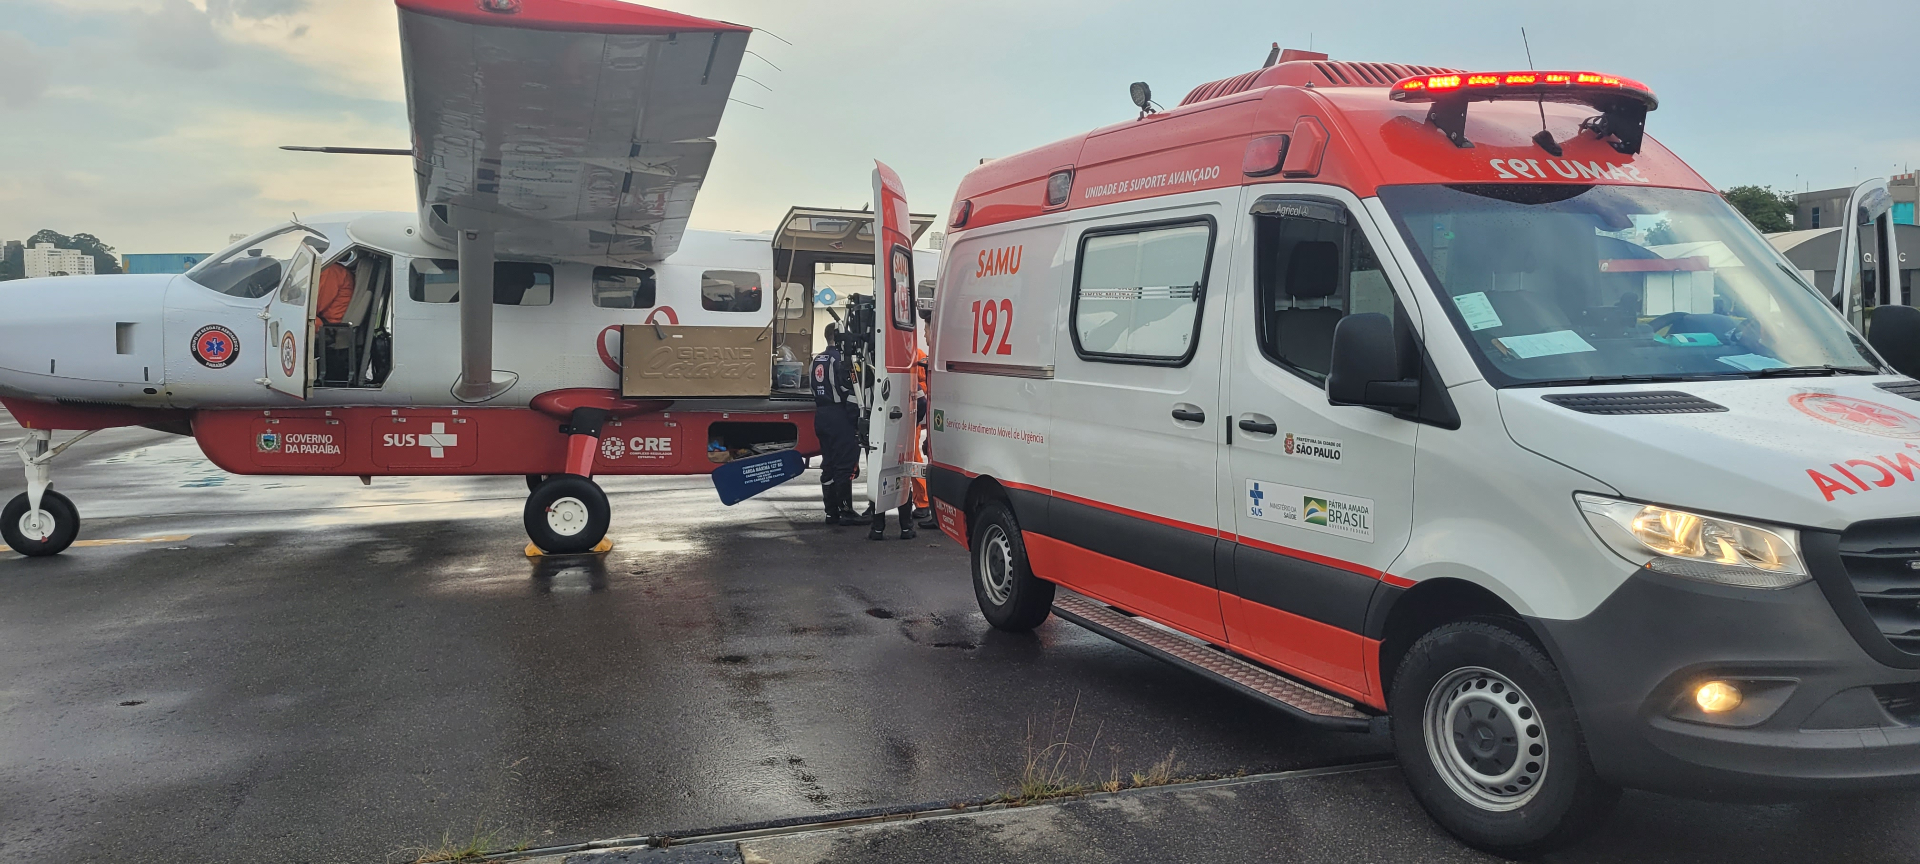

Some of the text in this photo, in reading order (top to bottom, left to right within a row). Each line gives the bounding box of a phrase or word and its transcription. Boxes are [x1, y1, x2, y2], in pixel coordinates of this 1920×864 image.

[1085, 165, 1220, 199] UNIDADE DE SUPORTE AVANÇADO
[975, 245, 1023, 278] SAMU
[971, 298, 1013, 355] 192
[677, 346, 755, 360] GRAND
[945, 417, 1044, 444] Serviço de Atendimento Móvel de Urgência
[285, 433, 333, 444] GOVERNO
[383, 433, 415, 447] SUS
[630, 436, 672, 451] CRE
[285, 442, 341, 454] DA PARAÍBA
[1296, 442, 1341, 460] SÃO PAULO
[1251, 506, 1263, 517] SUS
[1269, 502, 1291, 512] MINISTÉRIO
[1328, 499, 1369, 514] PÁTRIA AMADA
[1283, 511, 1298, 521] SAÚDE
[1328, 508, 1369, 530] BRASIL
